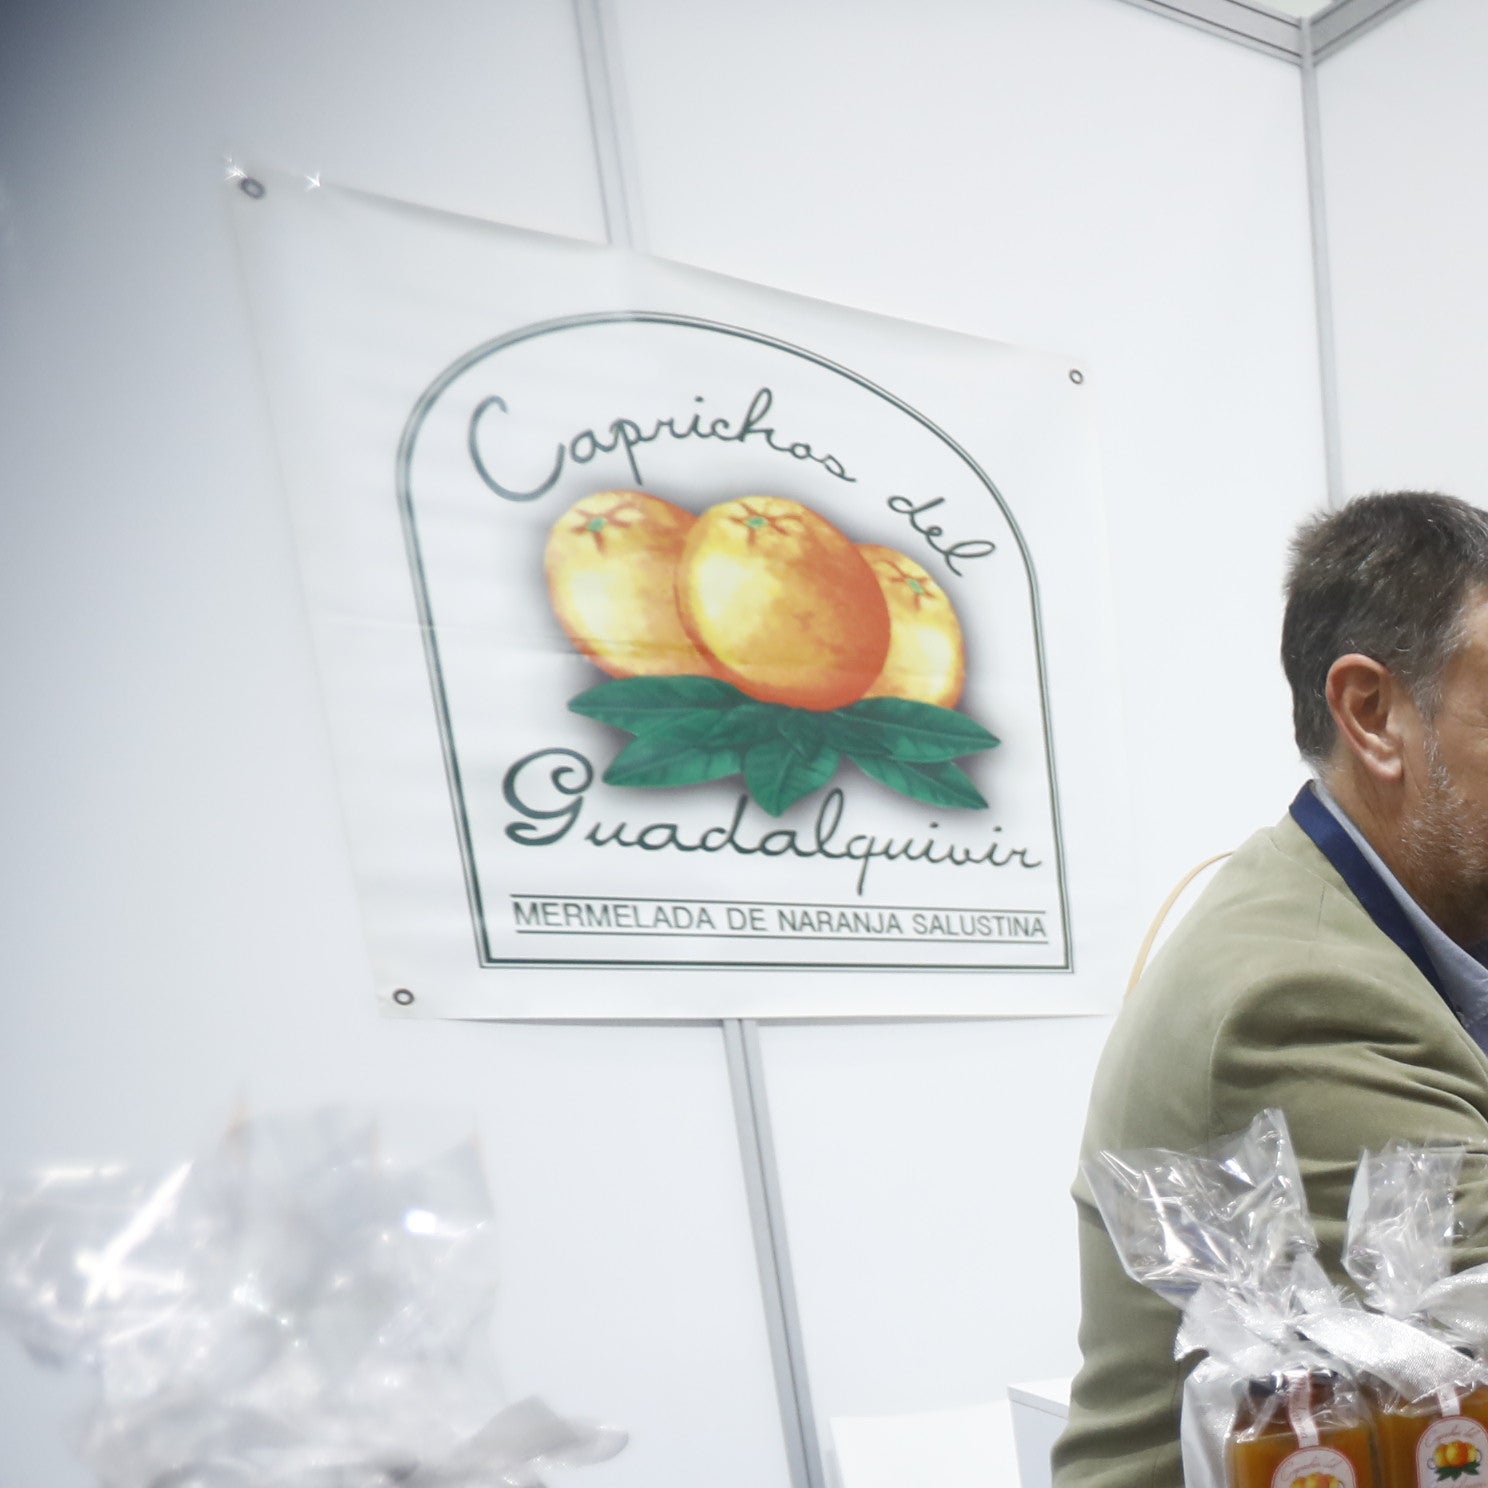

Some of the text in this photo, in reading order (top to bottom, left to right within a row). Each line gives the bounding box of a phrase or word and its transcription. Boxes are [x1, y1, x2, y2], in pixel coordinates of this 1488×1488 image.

[467, 388, 997, 578] Caprichos del
[501, 747, 1045, 896] Guadalquivir
[512, 899, 1048, 940] MERMELADA DE NARANJA SALUSTINA
